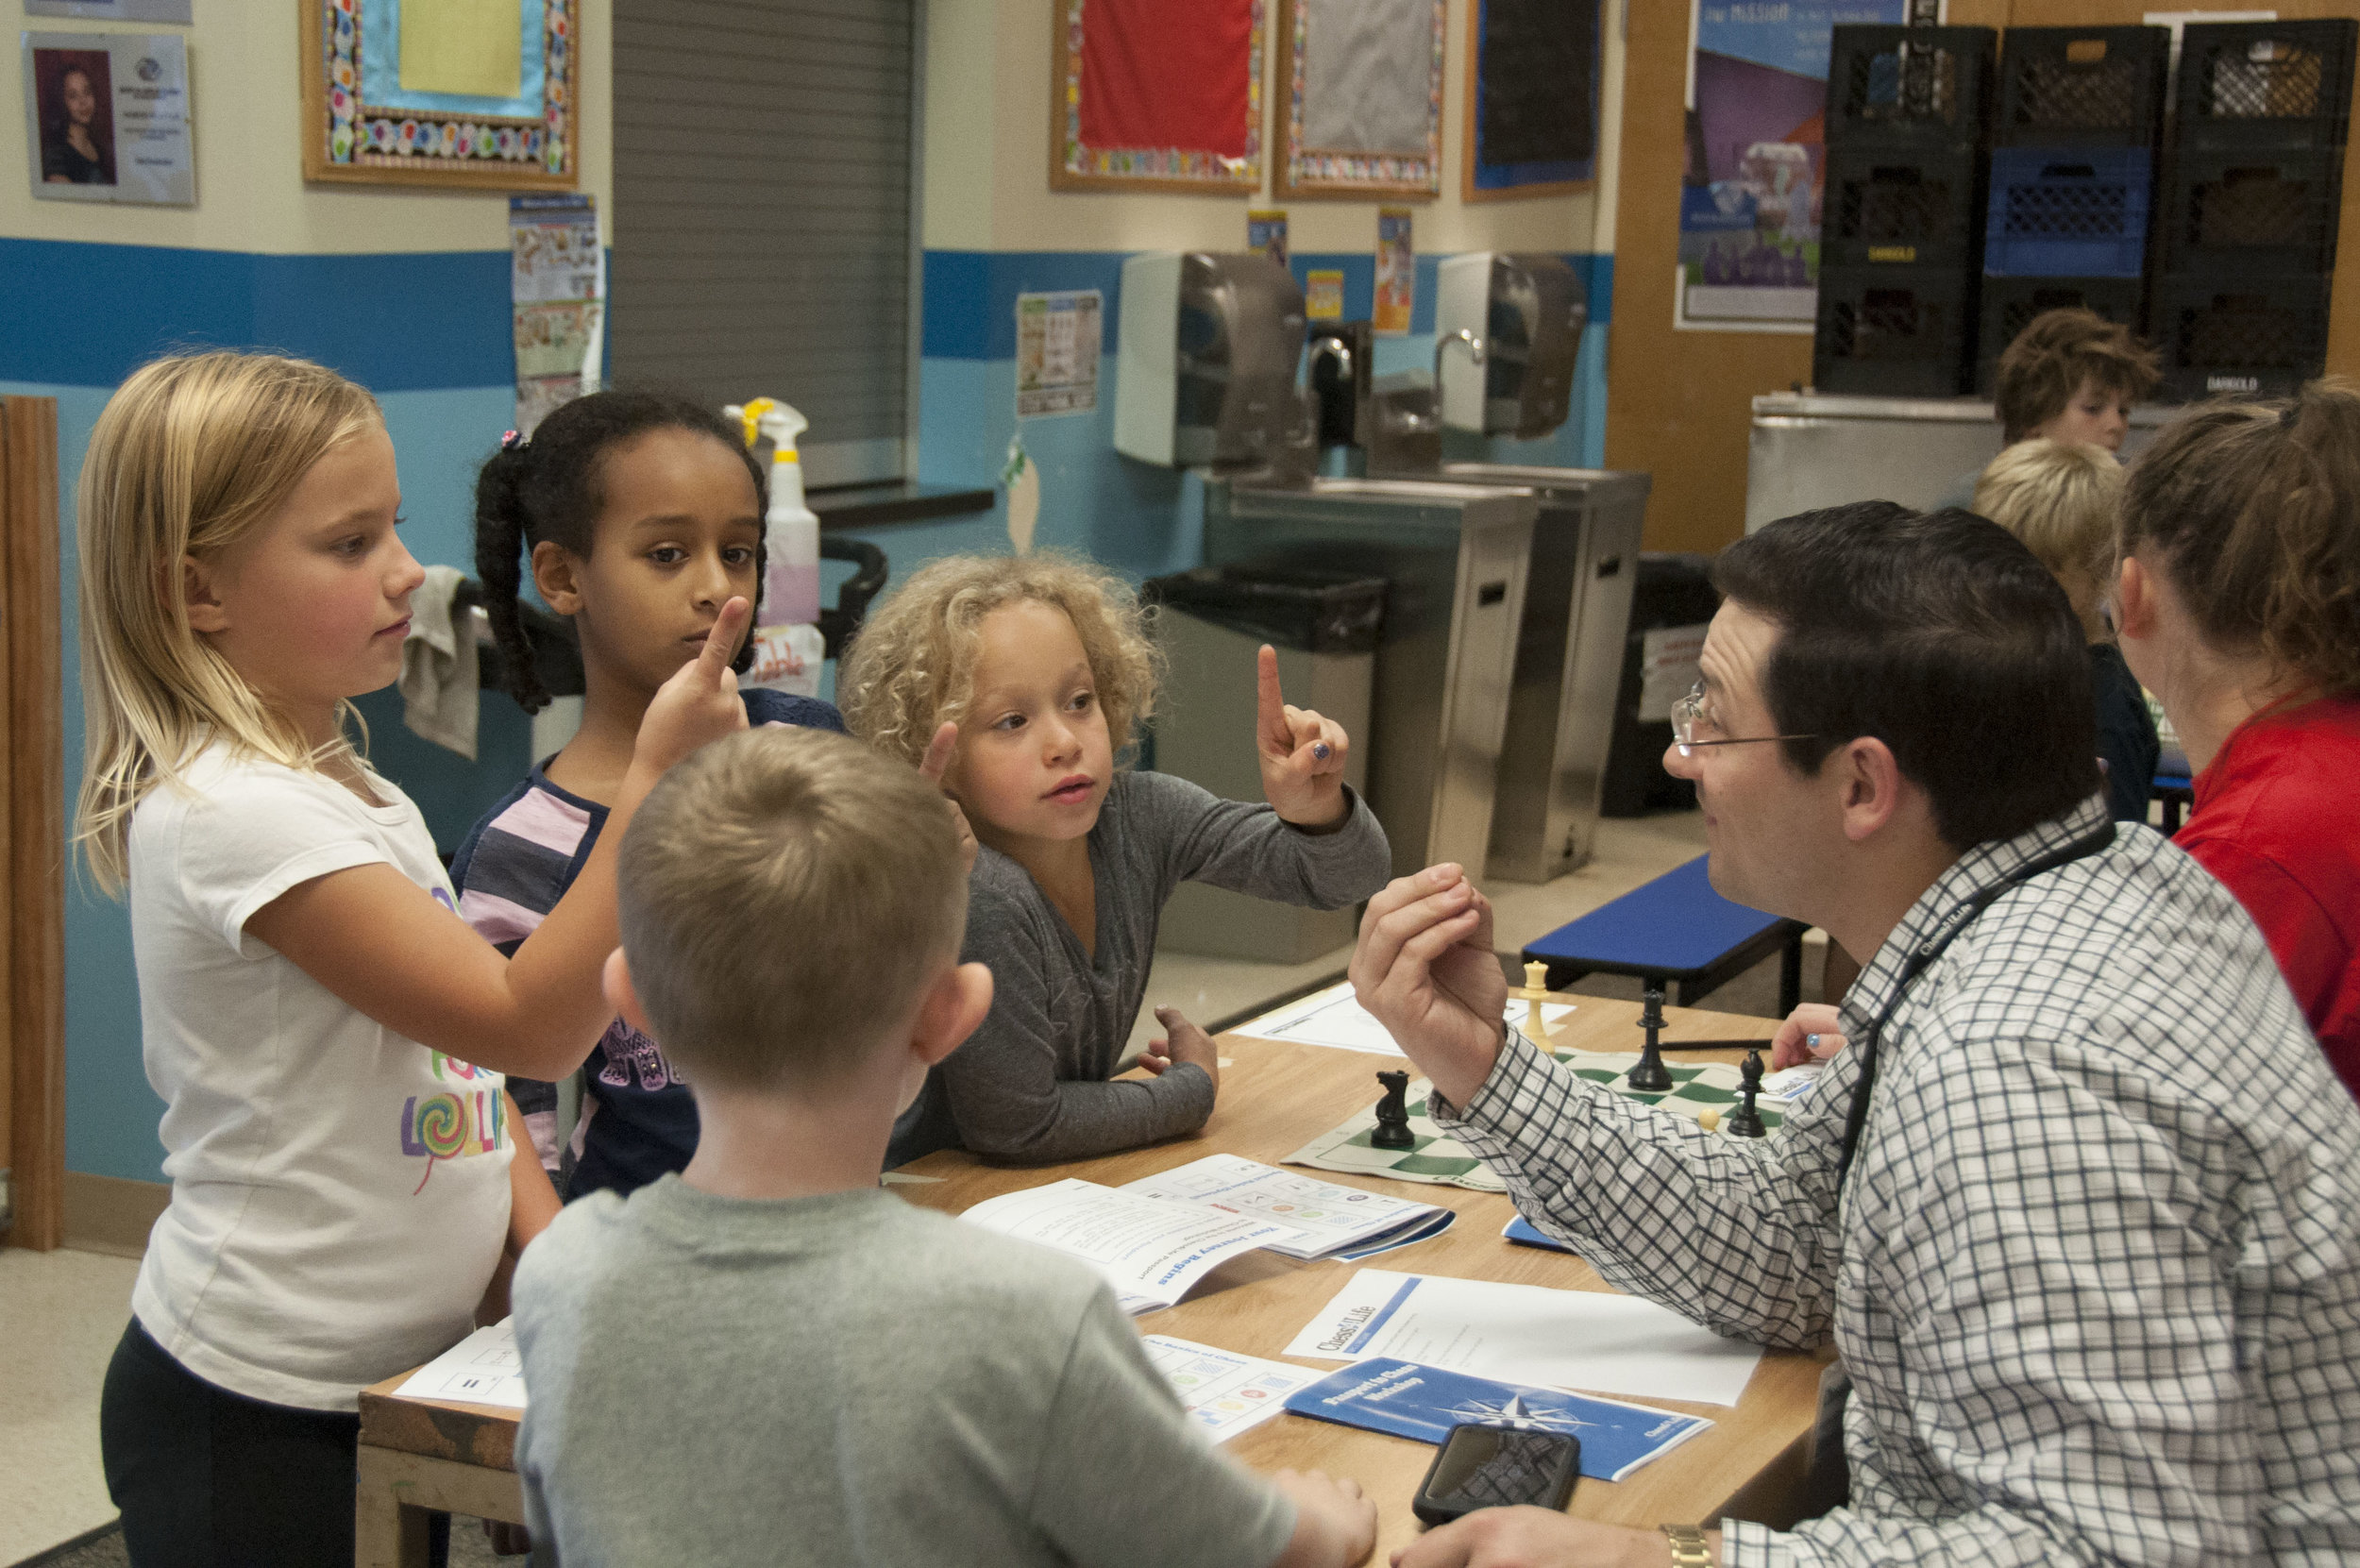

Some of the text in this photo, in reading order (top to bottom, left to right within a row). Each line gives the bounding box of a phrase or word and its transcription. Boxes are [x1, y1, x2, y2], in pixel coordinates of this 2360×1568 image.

[1199, 1236, 1249, 1255] Journey
[1138, 1256, 1169, 1280] Passport
[1157, 1254, 1202, 1286] Begins
